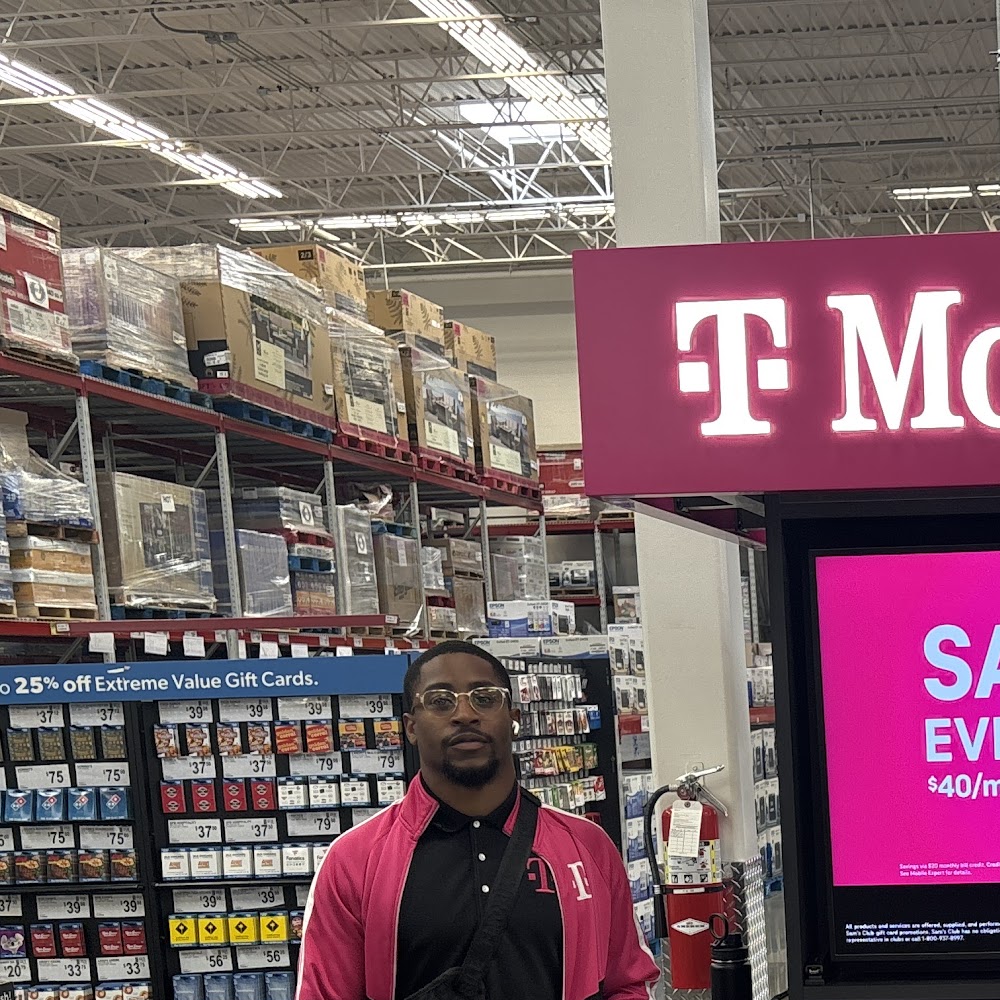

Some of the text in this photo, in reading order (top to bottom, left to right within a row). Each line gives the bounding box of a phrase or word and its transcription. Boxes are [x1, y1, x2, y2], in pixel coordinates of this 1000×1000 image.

[300, 251, 312, 259] 2/3
[14, 676, 59, 694] 25%
[62, 674, 91, 692] off
[94, 676, 168, 691] Extreme
[171, 673, 221, 689] Value
[224, 671, 258, 688] Gift
[261, 670, 318, 686] Cards.
